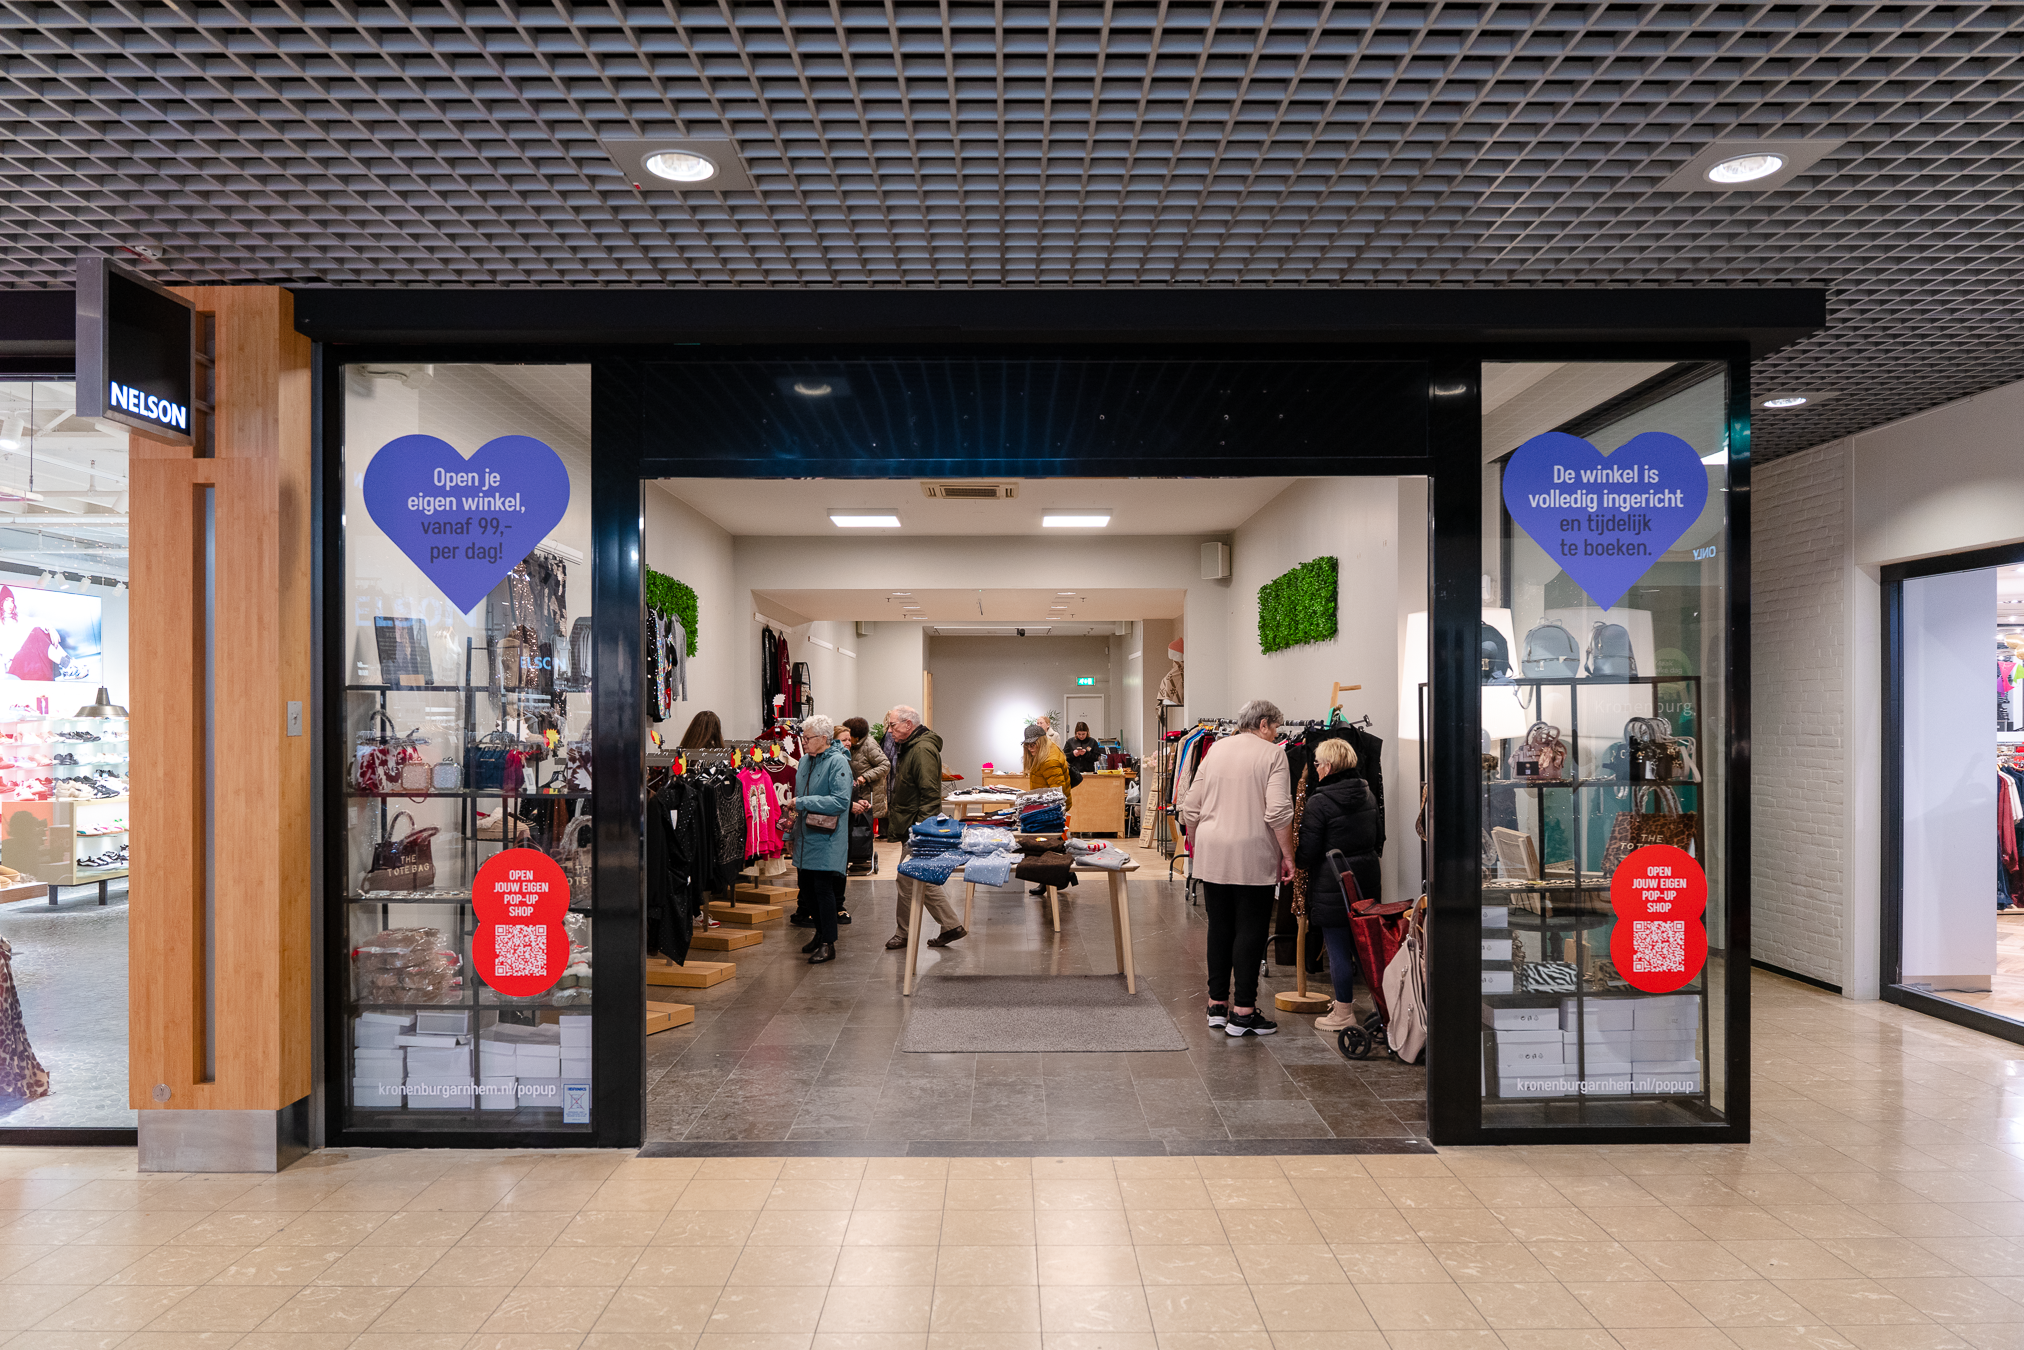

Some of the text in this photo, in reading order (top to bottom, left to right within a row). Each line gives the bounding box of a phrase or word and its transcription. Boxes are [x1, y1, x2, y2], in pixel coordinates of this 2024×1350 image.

[110, 380, 186, 430] NELSON
[433, 467, 501, 491] Open je
[1553, 465, 1659, 484] De winkel is
[407, 492, 526, 515] eigen winkel,
[1529, 489, 1684, 512] volledig ingericht
[421, 517, 512, 538] vanaf 99,-
[1560, 514, 1652, 536] en tijdelijk
[430, 542, 503, 564] per dag!
[1560, 538, 1652, 556] te boeken.
[1641, 834, 1664, 843] THE
[400, 854, 417, 864] THE
[386, 862, 430, 878] TOTE BAG
[509, 869, 533, 881] OPEN
[575, 865, 590, 875] TH
[1647, 866, 1672, 877] OPEN
[493, 882, 549, 893] JOUW EIGEN
[567, 876, 588, 886] OTE
[1632, 878, 1687, 889] JOUW EIGEN
[504, 894, 539, 905] POP-UP
[1642, 890, 1677, 901] POP-UP
[508, 906, 534, 917] SHOP
[1647, 902, 1672, 913] SHOP
[378, 1082, 556, 1098] kronenburgarnhem.nl/popup
[1516, 1078, 1694, 1094] kronenburgarnhem.nl/popup
